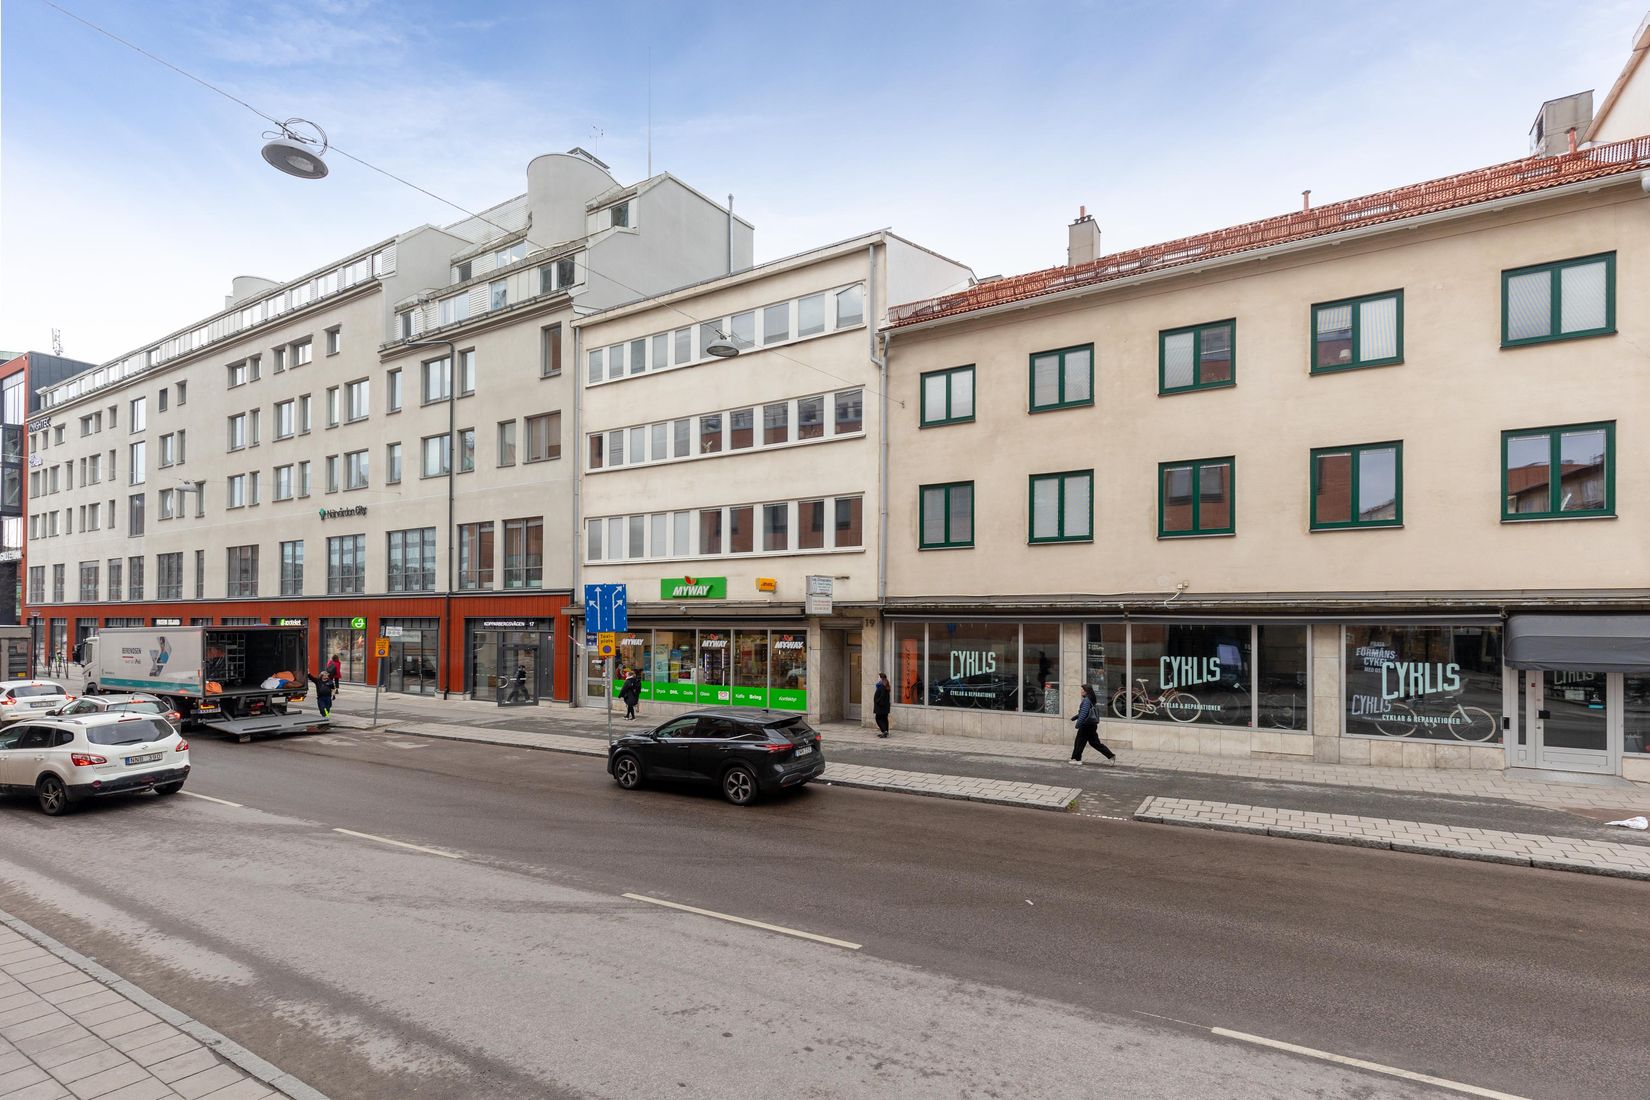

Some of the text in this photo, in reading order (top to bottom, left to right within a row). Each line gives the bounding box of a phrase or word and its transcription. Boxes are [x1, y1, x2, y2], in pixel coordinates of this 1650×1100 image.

[672, 585, 710, 596] MYWAY
[865, 618, 876, 628] 19
[621, 638, 644, 646] MYWAY
[701, 639, 728, 648] MYWAY
[774, 641, 804, 650] MYWAY
[950, 650, 996, 680] CYKLIS
[1160, 655, 1221, 690] CYKLIS
[1381, 661, 1461, 700] CYKLIS
[968, 691, 996, 699] REPARATIONER
[1184, 703, 1221, 712] REPARATIONER
[1351, 694, 1392, 716] CYKLIS
[1382, 714, 1406, 722] CYKLAR
[1413, 715, 1461, 725] REPARATIONER
